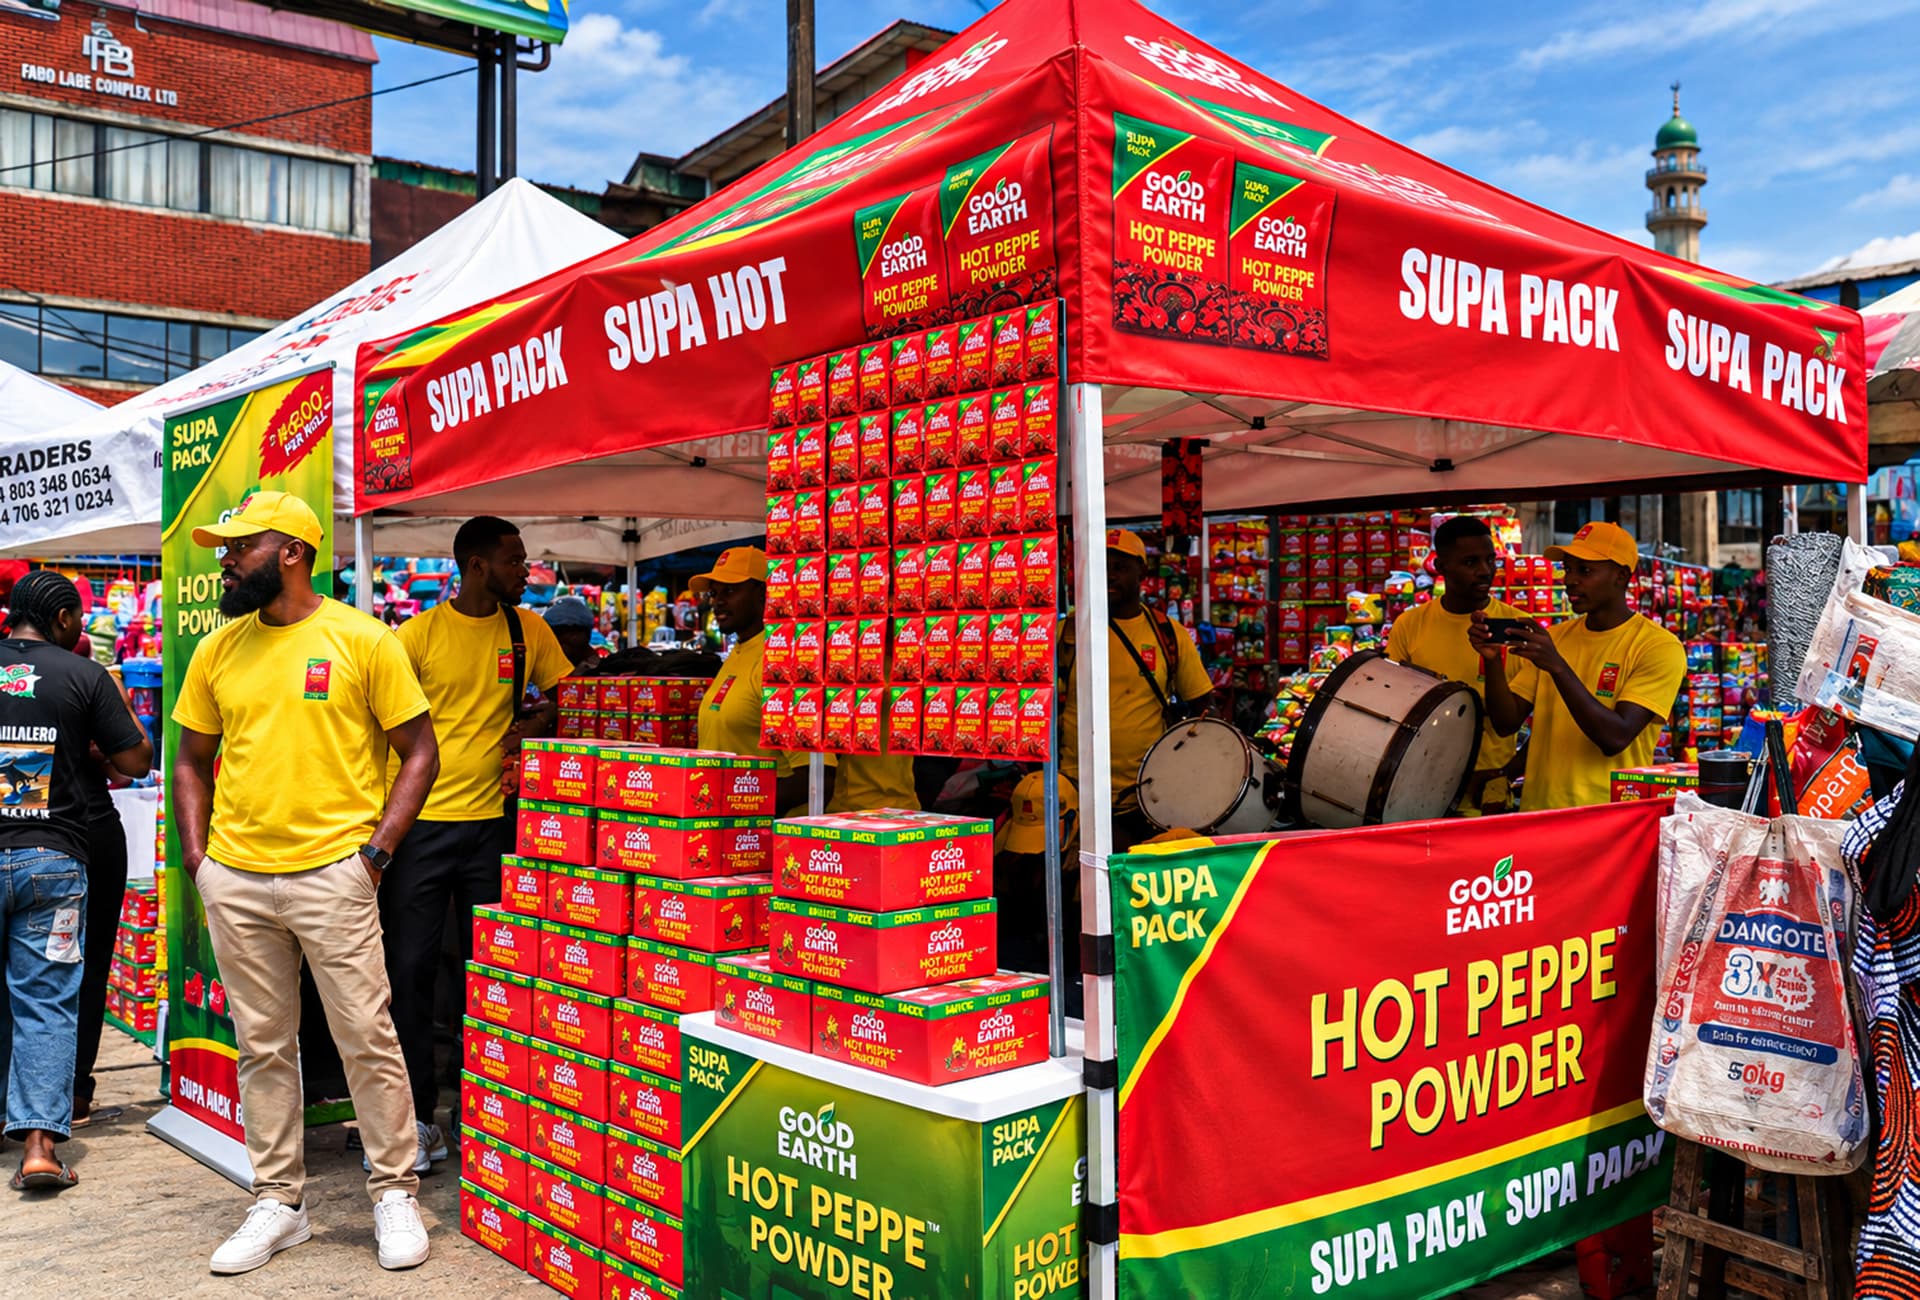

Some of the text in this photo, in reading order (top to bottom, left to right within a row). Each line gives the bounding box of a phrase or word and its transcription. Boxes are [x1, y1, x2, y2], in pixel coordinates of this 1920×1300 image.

[59, 70, 92, 90] LABE
[156, 89, 178, 106] LTD
[969, 182, 1022, 214] GOOD
[1146, 171, 1204, 201] GOOD
[968, 199, 1028, 236] EARTH
[1142, 190, 1205, 223] EARTH
[1130, 220, 1215, 257] HOT PEPPE
[1254, 232, 1307, 258] EARTH
[1259, 217, 1306, 240] GOOD
[881, 250, 927, 278] EARTH
[882, 235, 923, 260] GOOD
[960, 229, 1040, 271] HOT PEPPE
[1143, 245, 1203, 272] POWDER
[971, 255, 1027, 285] POWDER
[1242, 257, 1314, 289] HOT PEPPE
[873, 274, 938, 306] HOT PEPPE
[883, 295, 928, 318] POWDER
[1253, 278, 1303, 301] POWDER
[1399, 247, 1620, 352] SUPA PACK
[604, 255, 788, 371] SUPA HOT
[426, 325, 568, 433] SUPA PACK
[1665, 308, 1847, 424] SUPA PACK
[173, 416, 219, 447] SUPA
[172, 443, 212, 471] PACK
[9, 480, 35, 501] 803
[40, 473, 68, 495] 348
[72, 465, 112, 488] 0634
[13, 503, 40, 524] 706
[44, 496, 69, 518] 321
[75, 489, 114, 511] 0234
[178, 572, 222, 605] HOT
[1130, 864, 1218, 910] SUPA
[1449, 870, 1533, 906] GOOD
[1131, 908, 1209, 948] PACK
[1446, 895, 1535, 936] EARTH
[1720, 920, 1825, 953] DANGOTE
[1310, 967, 1450, 1080] HOT
[688, 1045, 731, 1076] SUPA
[180, 1075, 205, 1108] SUPA
[688, 1067, 726, 1094] PACK
[1371, 1023, 1586, 1151] POWDER
[778, 1106, 855, 1150] GOOD
[993, 1115, 1040, 1146] SUPA
[777, 1130, 857, 1180] EARTH
[992, 1137, 1036, 1167] PACK
[726, 1155, 799, 1219] HOT
[1310, 1221, 1398, 1294] SUPA
[1406, 1191, 1488, 1263] PACK
[1505, 1161, 1577, 1227] SUPA
[1586, 1130, 1665, 1196] PACK
[750, 1215, 894, 1300] POWDER
[1014, 1223, 1077, 1277] HOT
